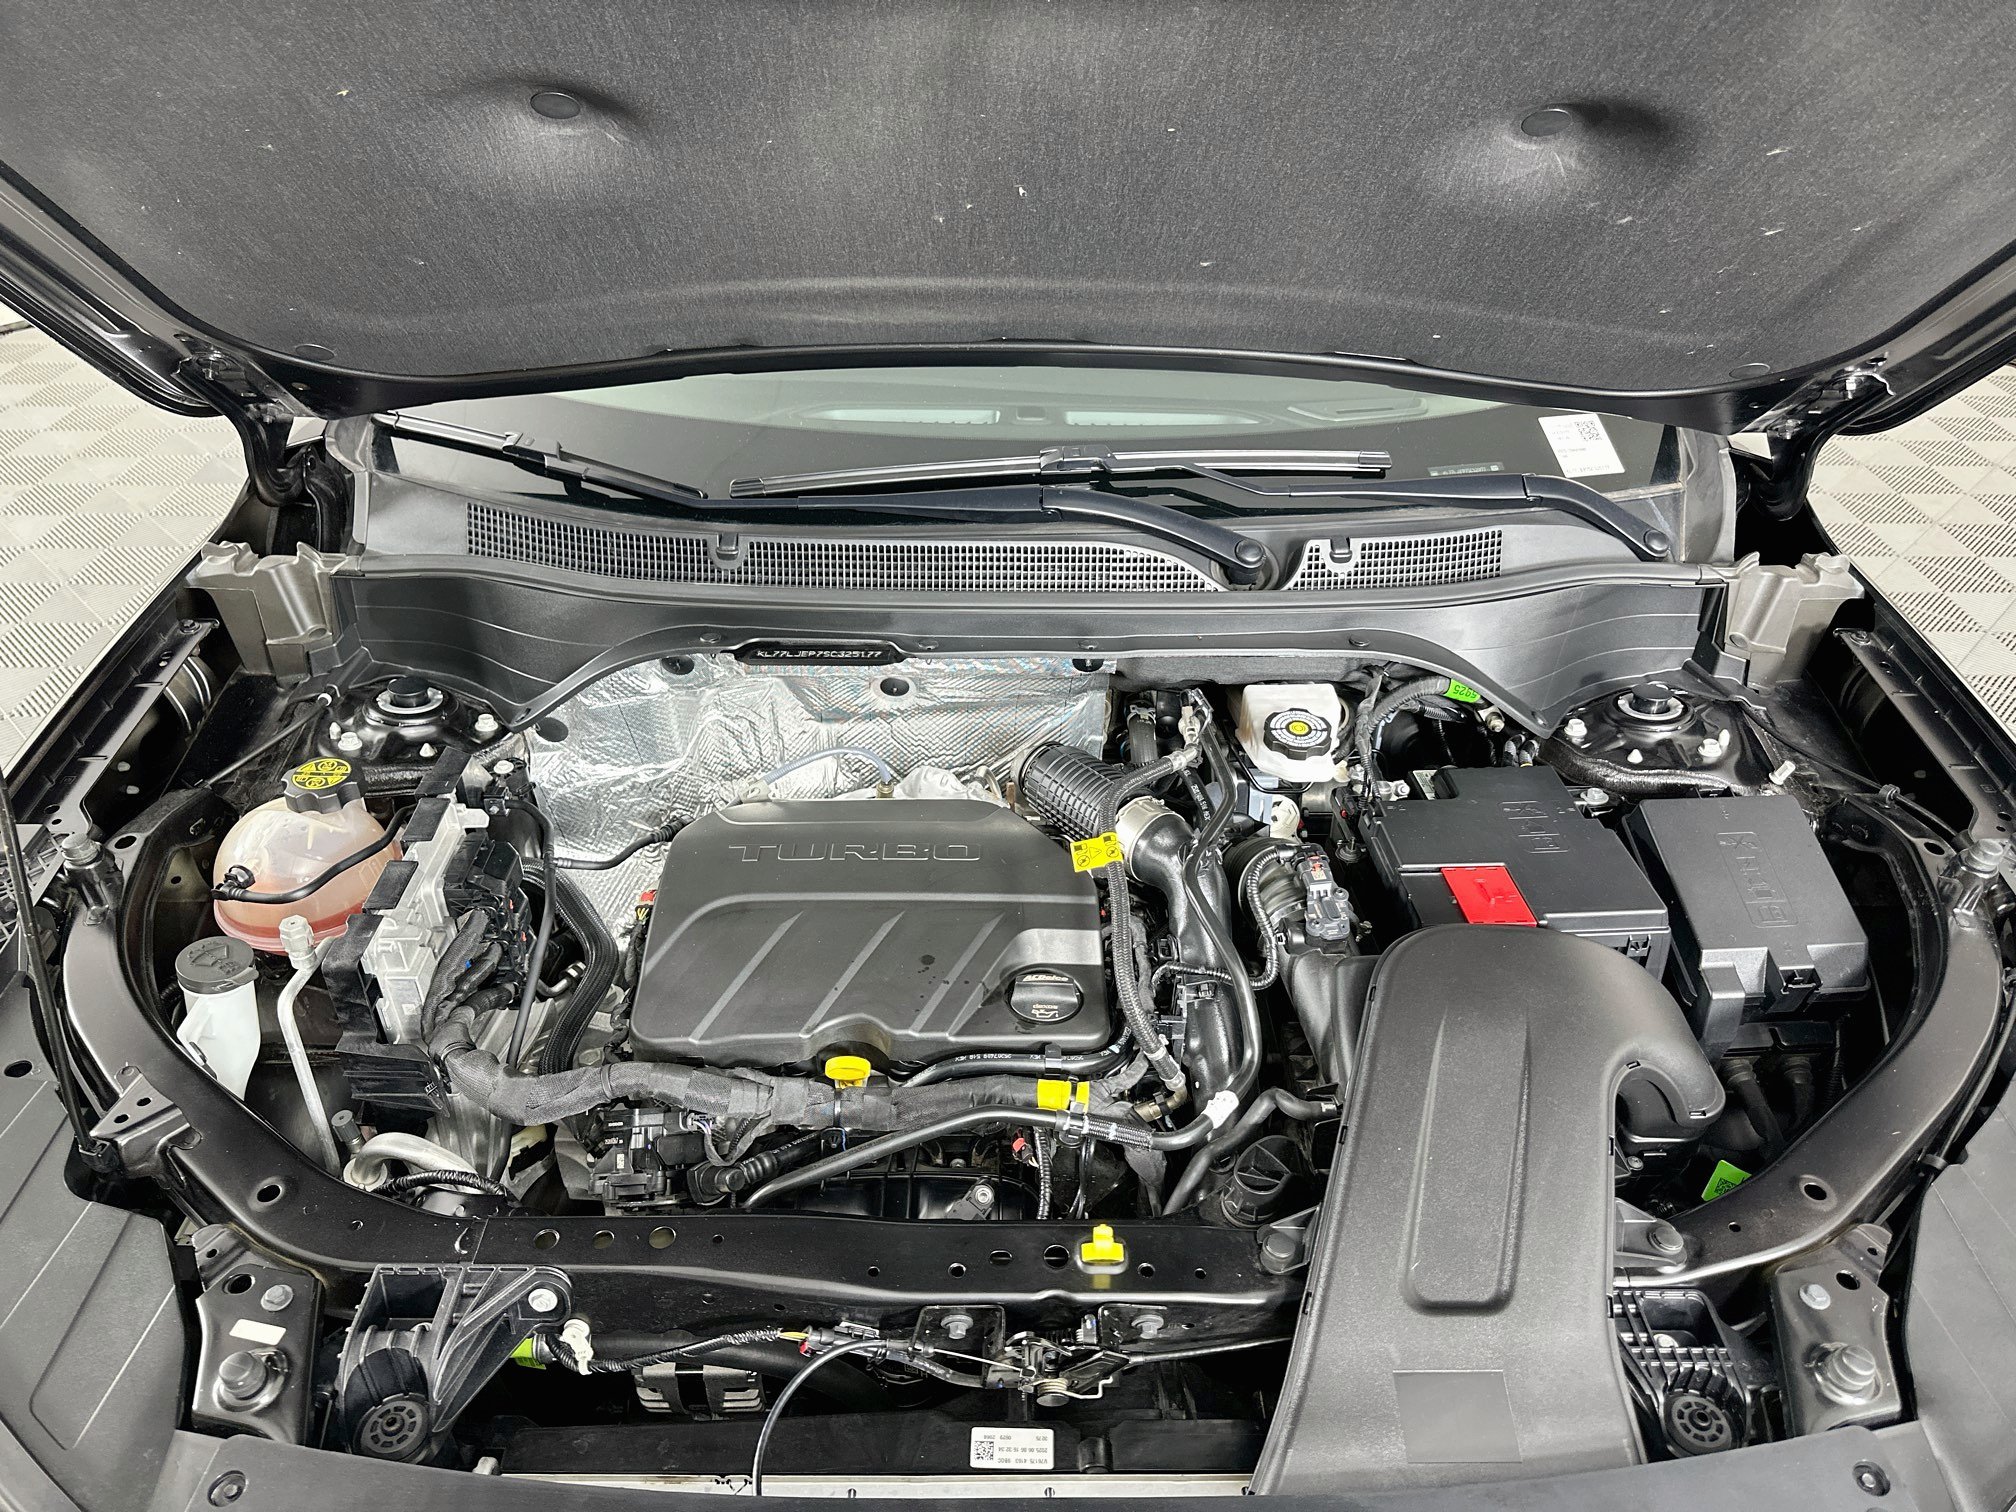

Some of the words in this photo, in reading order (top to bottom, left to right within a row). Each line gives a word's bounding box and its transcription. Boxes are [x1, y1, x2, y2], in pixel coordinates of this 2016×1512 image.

[756, 649, 883, 659] KL77LJEP7SC325177
[728, 842, 982, 863] TURBO
[1022, 974, 1069, 982] ACDelco
